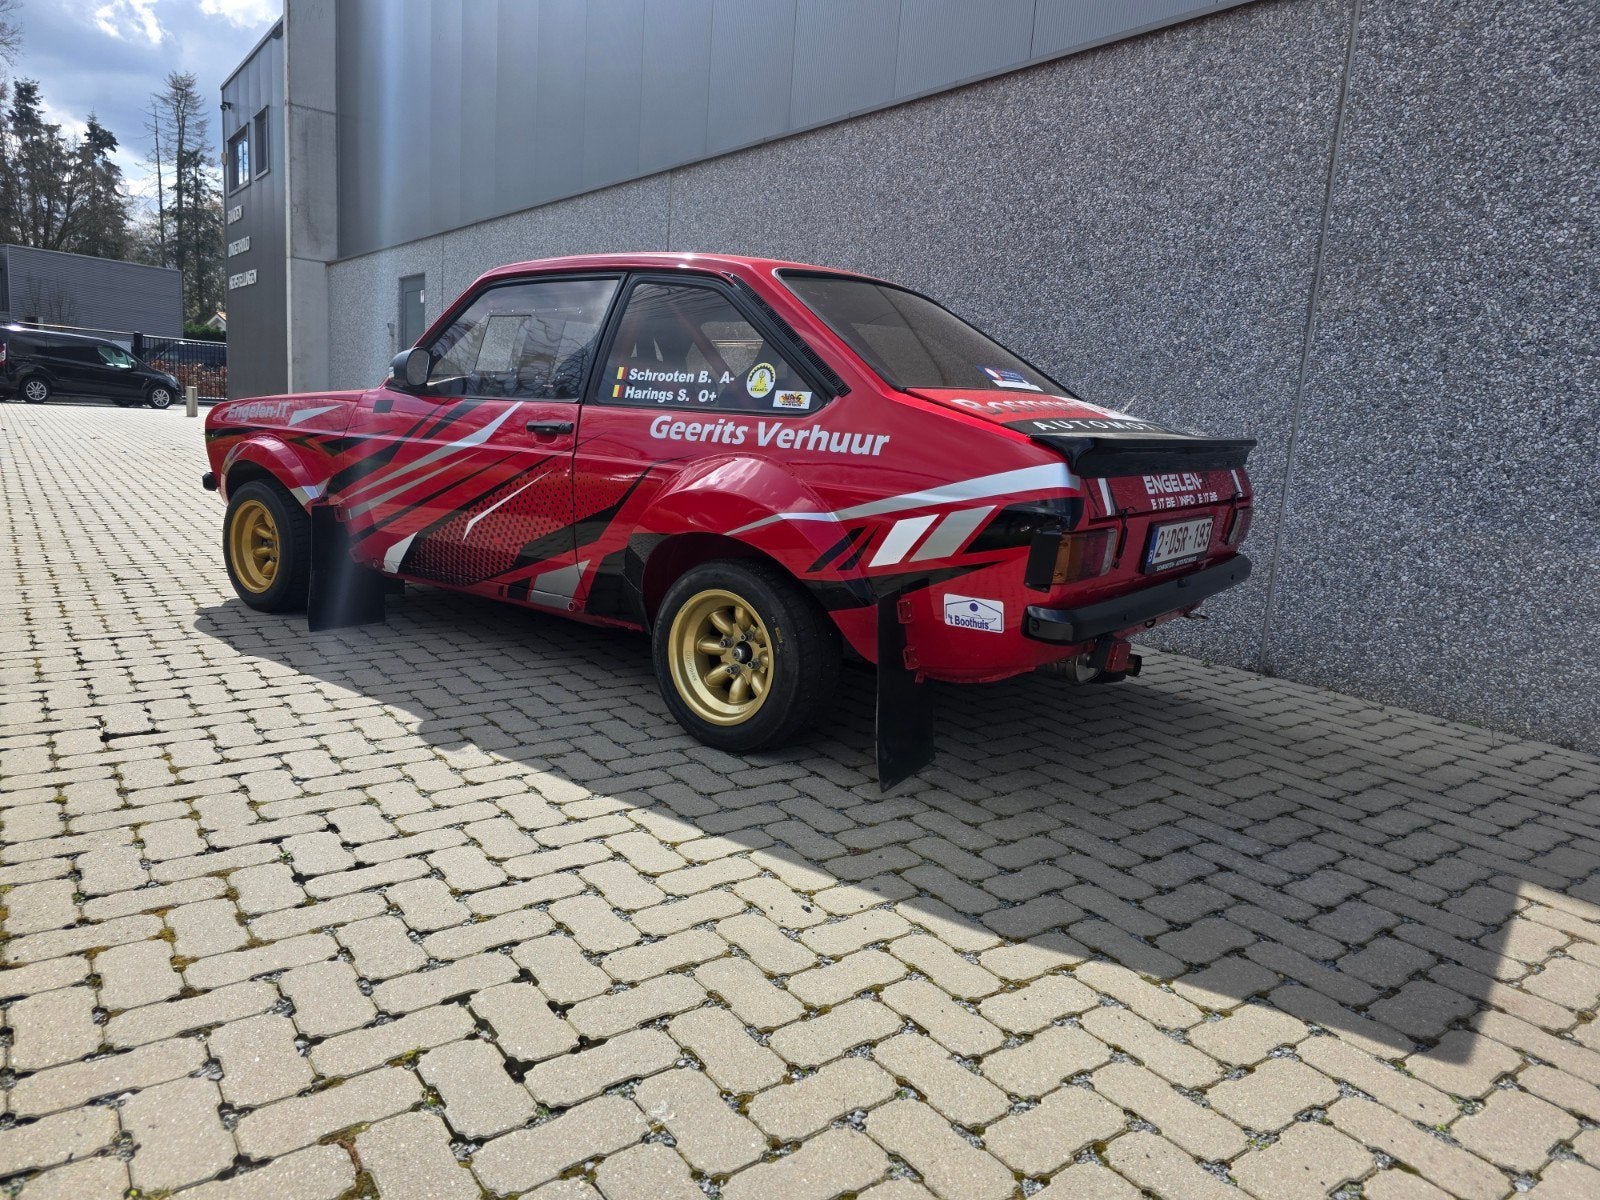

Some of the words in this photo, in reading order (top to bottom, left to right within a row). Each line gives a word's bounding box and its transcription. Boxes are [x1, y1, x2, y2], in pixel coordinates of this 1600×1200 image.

[629, 367, 695, 383] Schrooten
[698, 370, 712, 384] B.
[719, 370, 735, 384] A-
[624, 386, 674, 403] Harings
[677, 388, 690, 402] S.
[226, 402, 290, 423] Engelen-IT
[650, 415, 749, 445] Geerits
[757, 421, 890, 456] Verhuur
[954, 615, 989, 630] Boothuis
